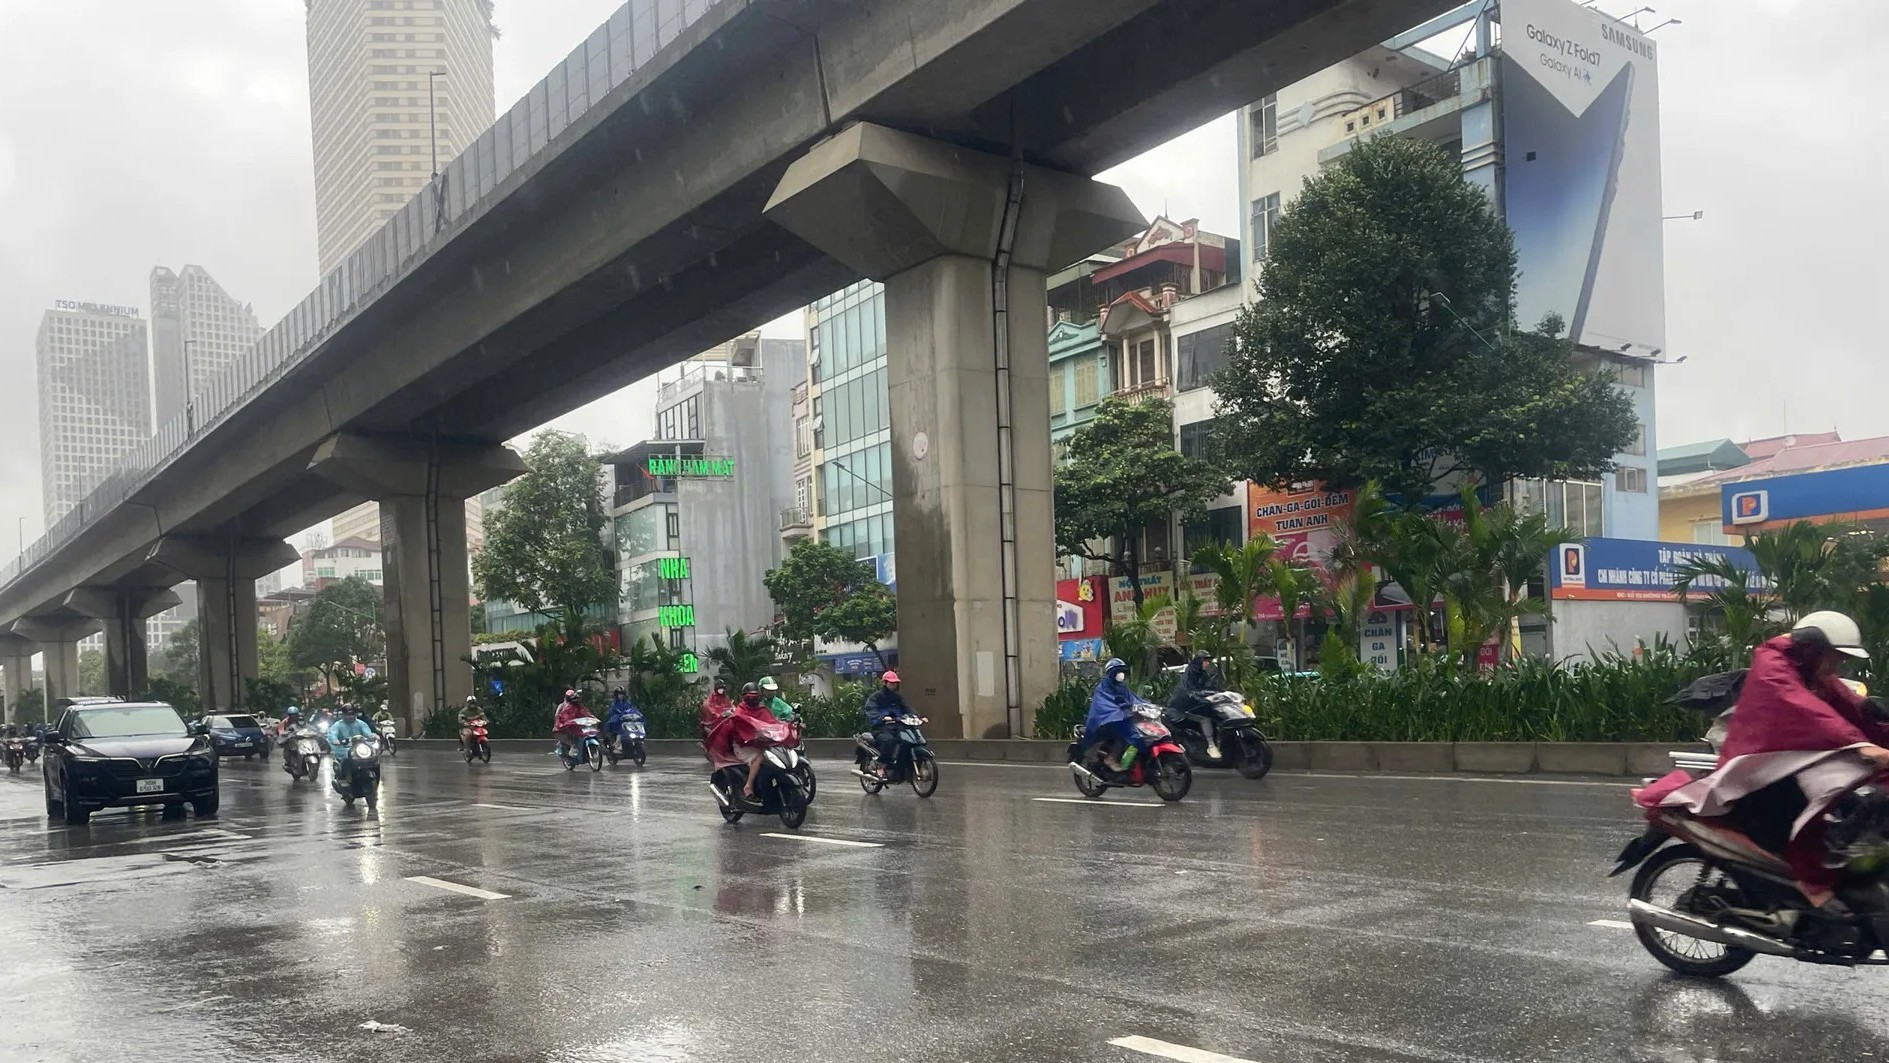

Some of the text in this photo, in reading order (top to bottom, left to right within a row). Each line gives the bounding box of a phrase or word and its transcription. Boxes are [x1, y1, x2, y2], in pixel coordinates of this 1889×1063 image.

[1526, 23, 1601, 67] Galaxy Z Fold7
[1601, 23, 1653, 60] SAMSUNG
[1540, 53, 1582, 81] Galaxy AI
[1306, 513, 1328, 527] ANH
[1658, 547, 1672, 567] TẬP
[659, 557, 689, 580] NHA
[1608, 567, 1628, 585] NHÁNH
[1628, 568, 1643, 585] CÔNG
[659, 605, 695, 627] KHOA
[1371, 641, 1386, 651] GA
